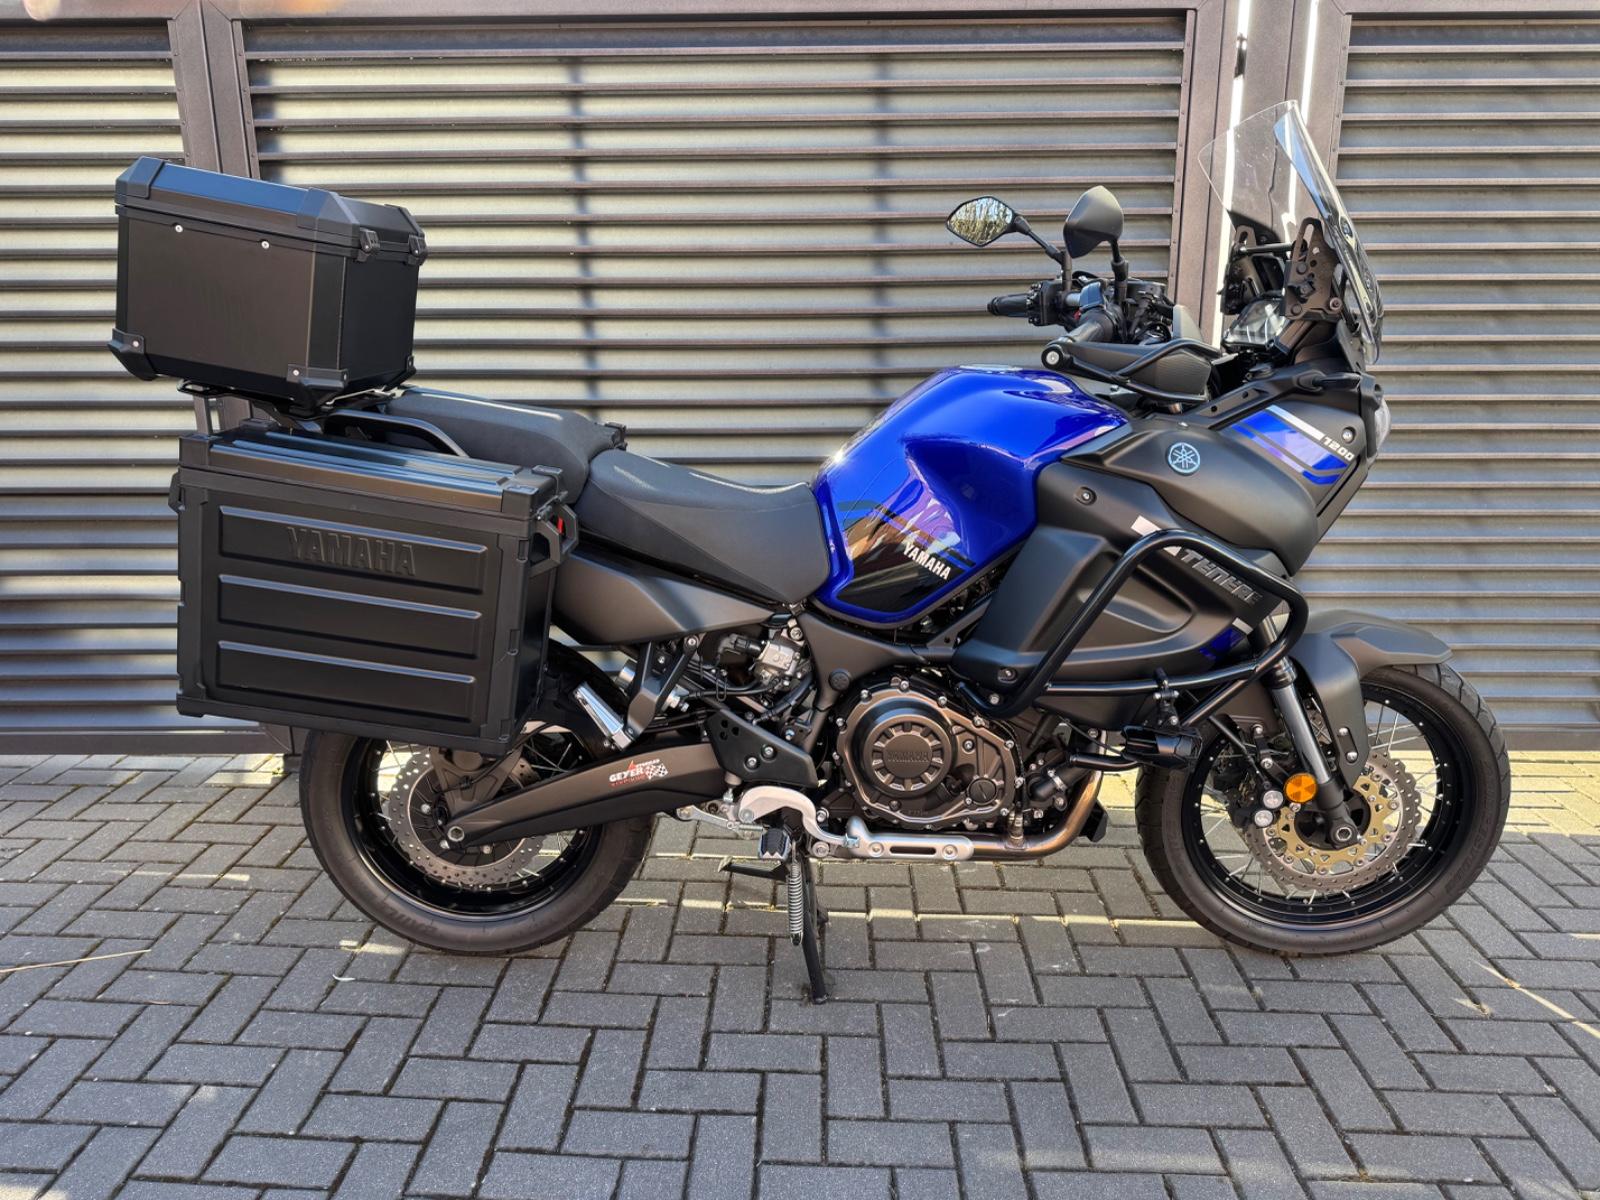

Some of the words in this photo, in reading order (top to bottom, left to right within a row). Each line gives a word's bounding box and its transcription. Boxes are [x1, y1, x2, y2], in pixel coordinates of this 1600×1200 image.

[1323, 436, 1355, 461] 1200
[287, 526, 416, 576] YAMAHA
[903, 542, 951, 580] YAMAHA
[609, 767, 645, 783] GEYER
